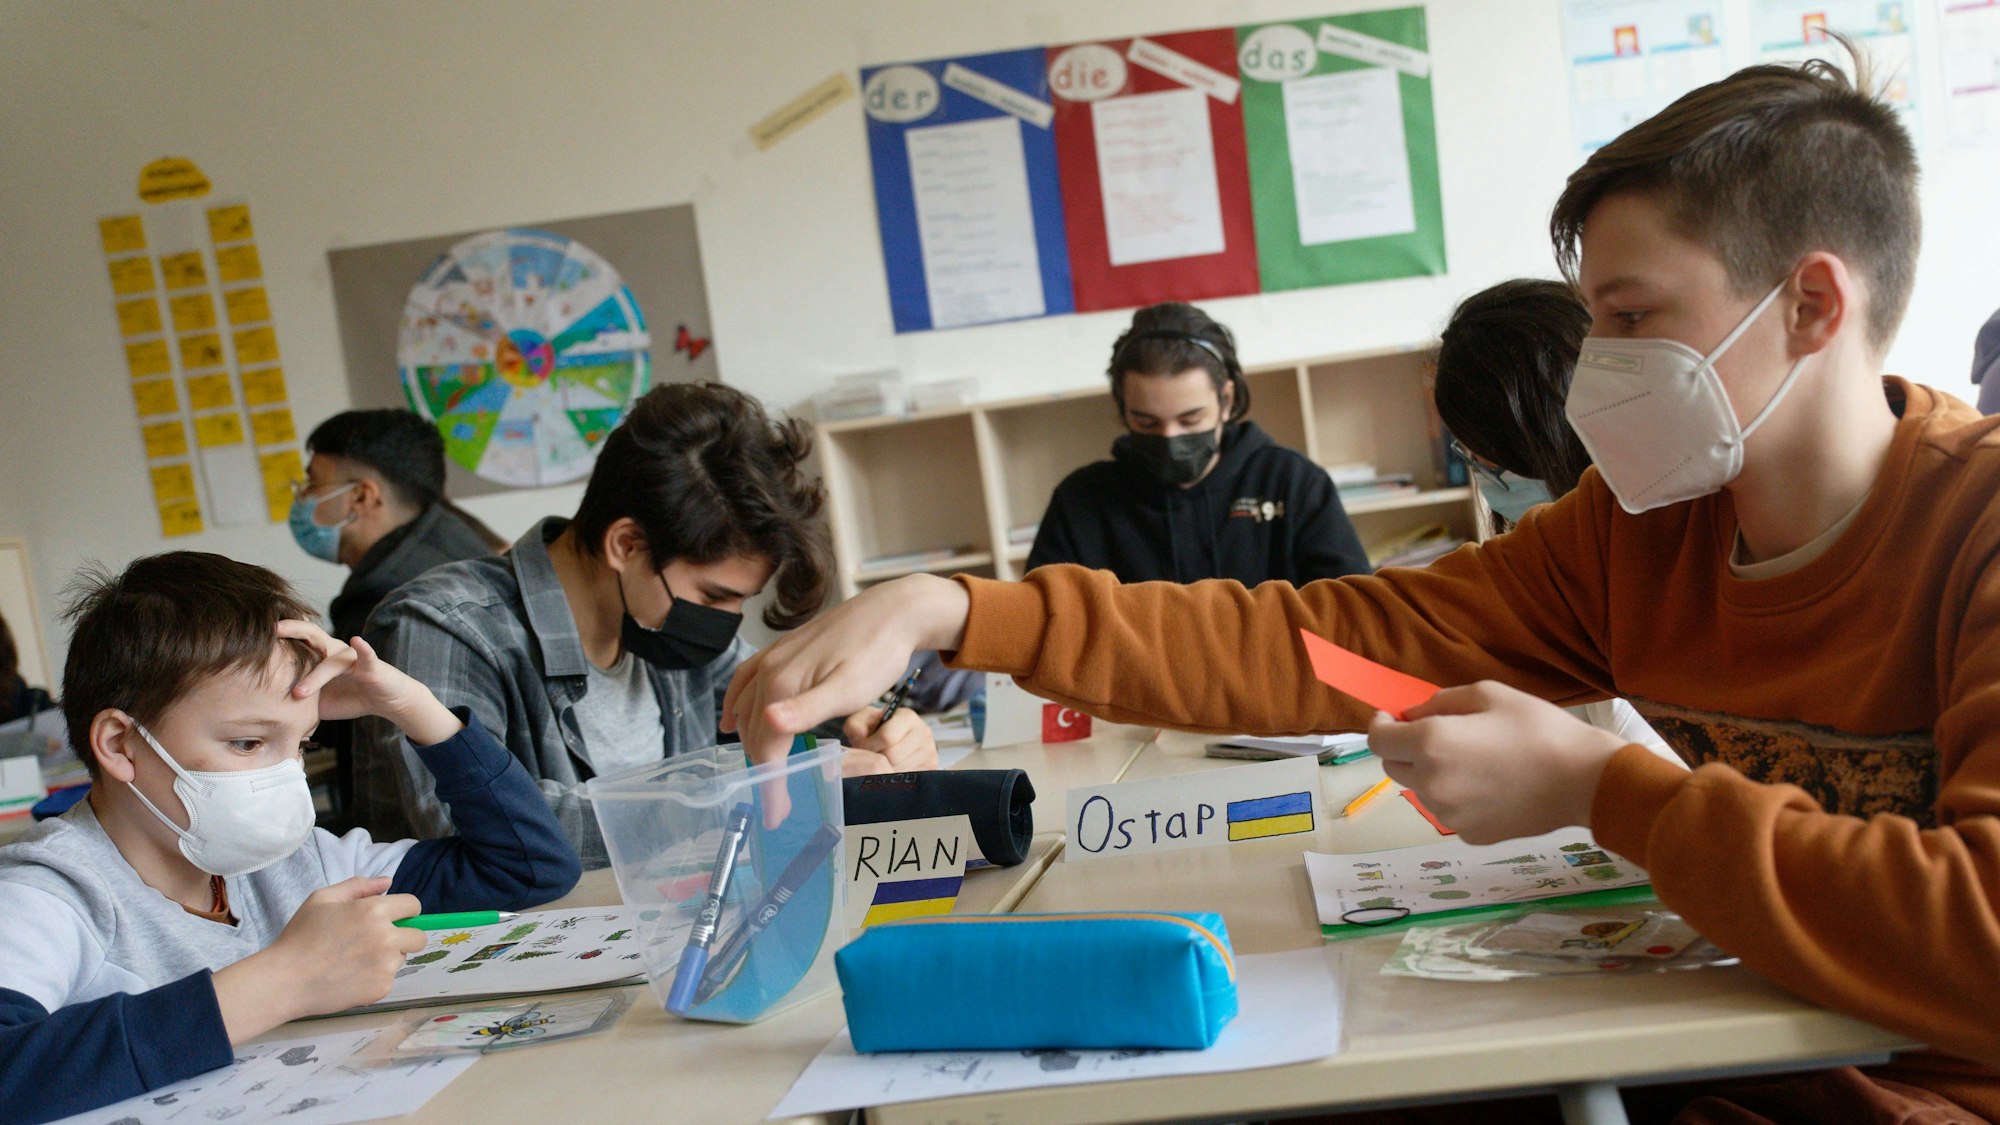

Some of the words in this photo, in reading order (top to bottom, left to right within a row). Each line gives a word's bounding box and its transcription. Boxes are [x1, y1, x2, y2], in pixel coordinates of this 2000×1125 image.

[1243, 39, 1306, 71] das
[1055, 60, 1108, 90] die
[867, 82, 930, 111] der
